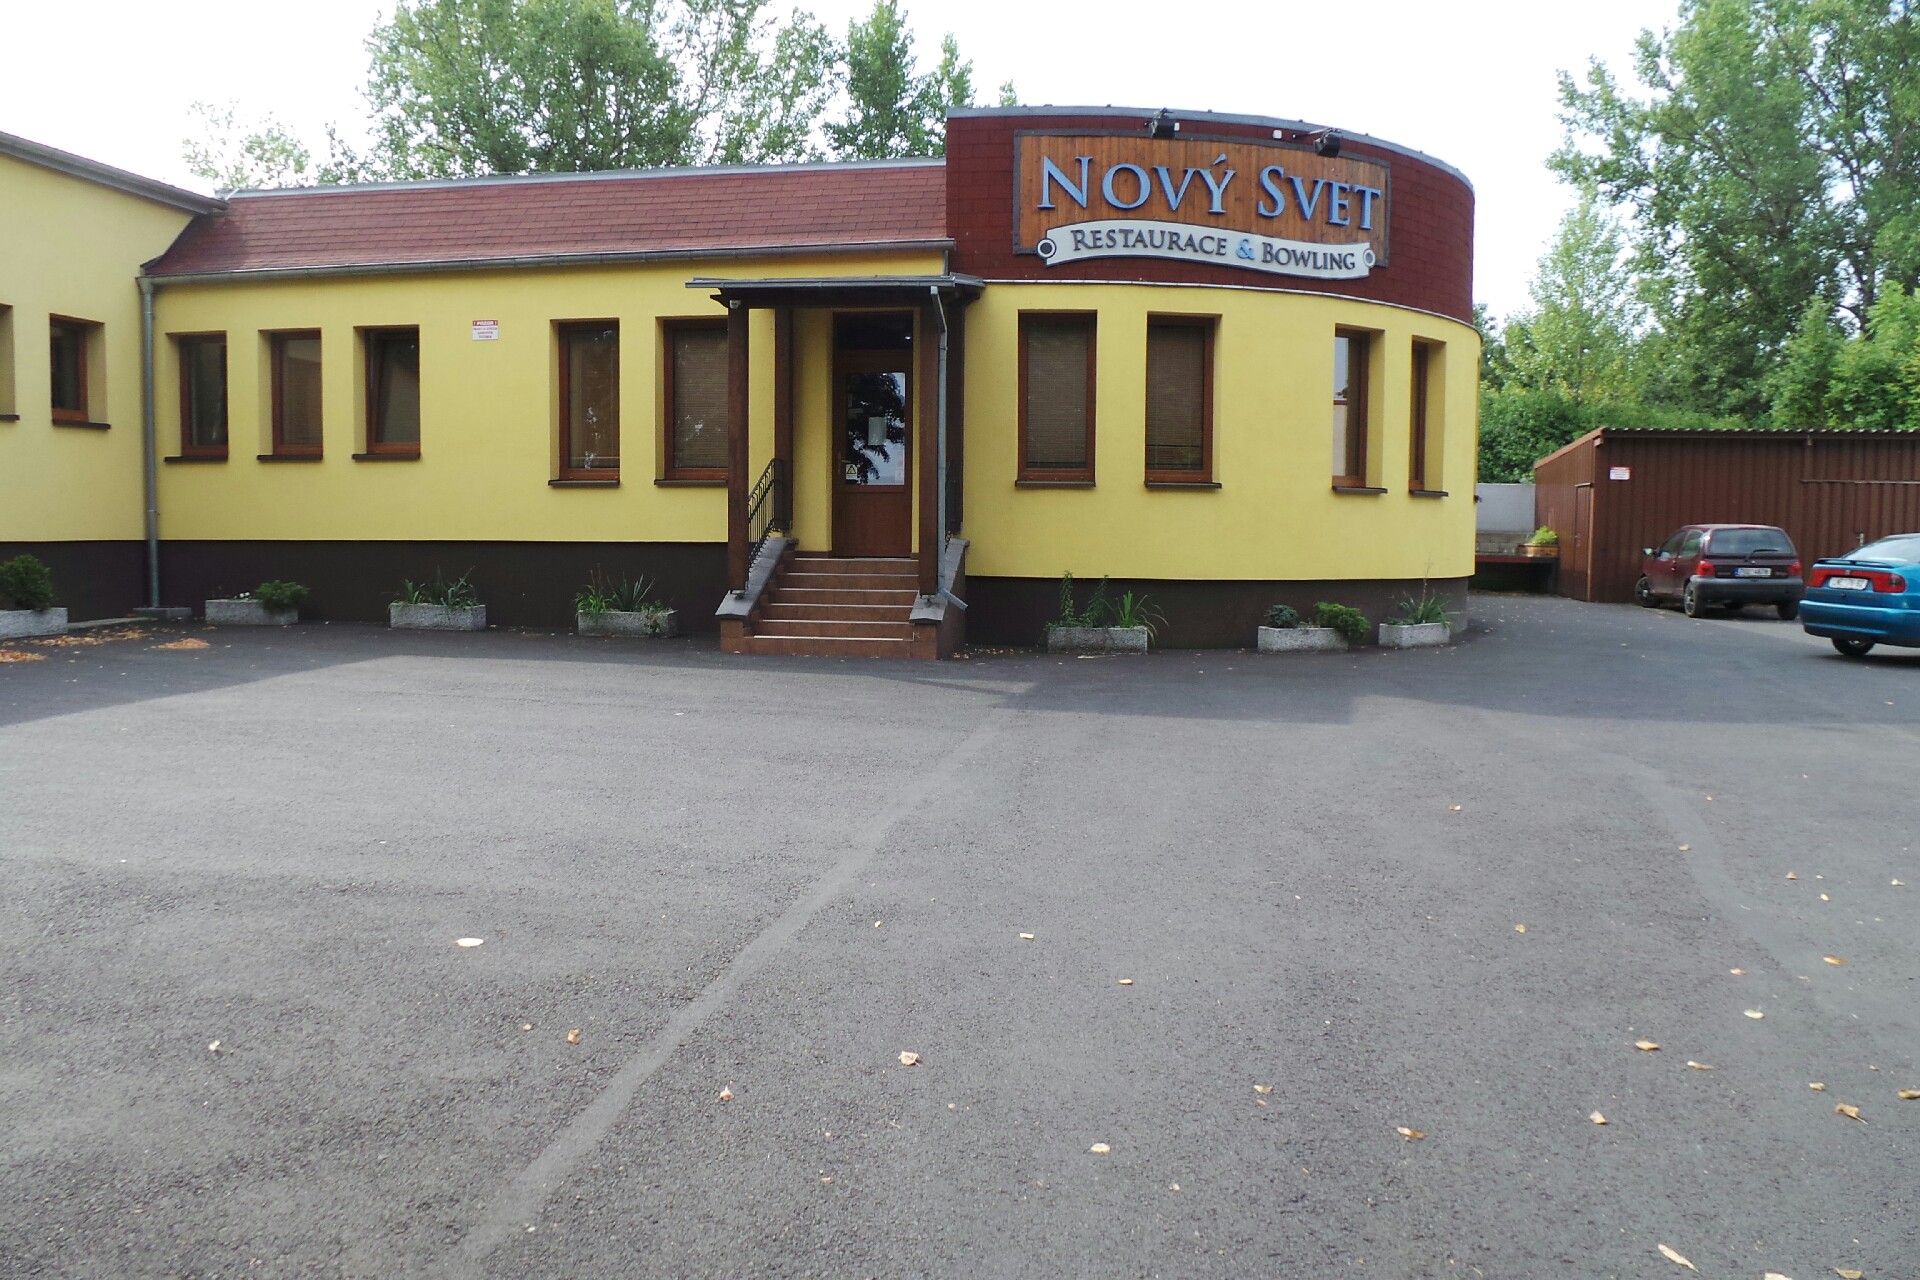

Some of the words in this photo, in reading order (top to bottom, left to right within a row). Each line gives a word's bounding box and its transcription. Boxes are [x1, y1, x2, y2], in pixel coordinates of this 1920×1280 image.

[1257, 165, 1382, 230] SVET
[1070, 228, 1227, 256] RESTAURACE
[1236, 238, 1255, 261] &
[1261, 241, 1356, 271] BOWLING
